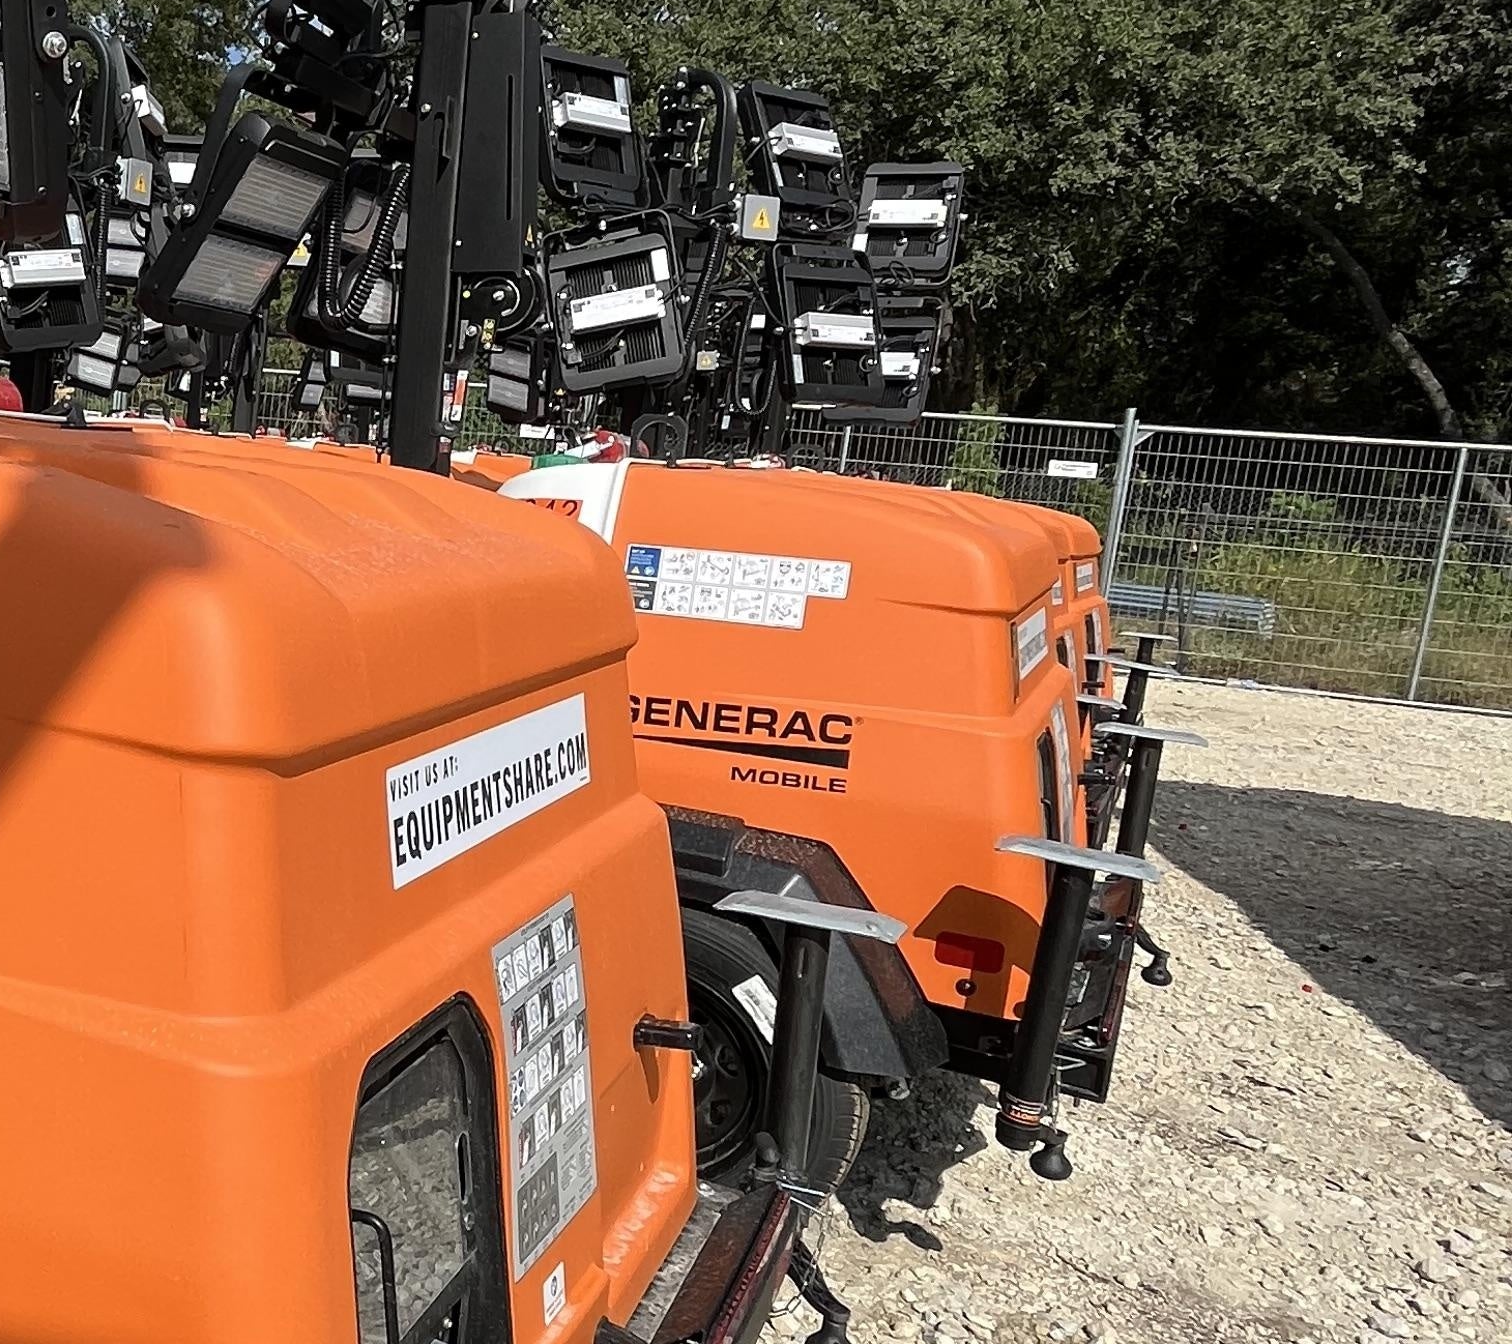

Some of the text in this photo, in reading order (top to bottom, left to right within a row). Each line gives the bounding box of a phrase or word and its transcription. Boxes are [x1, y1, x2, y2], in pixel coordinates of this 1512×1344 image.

[390, 755, 459, 802] VISIT US AT:
[393, 732, 587, 867] EQUIPMENTSHARE.COM
[731, 766, 848, 793] MOBILE
